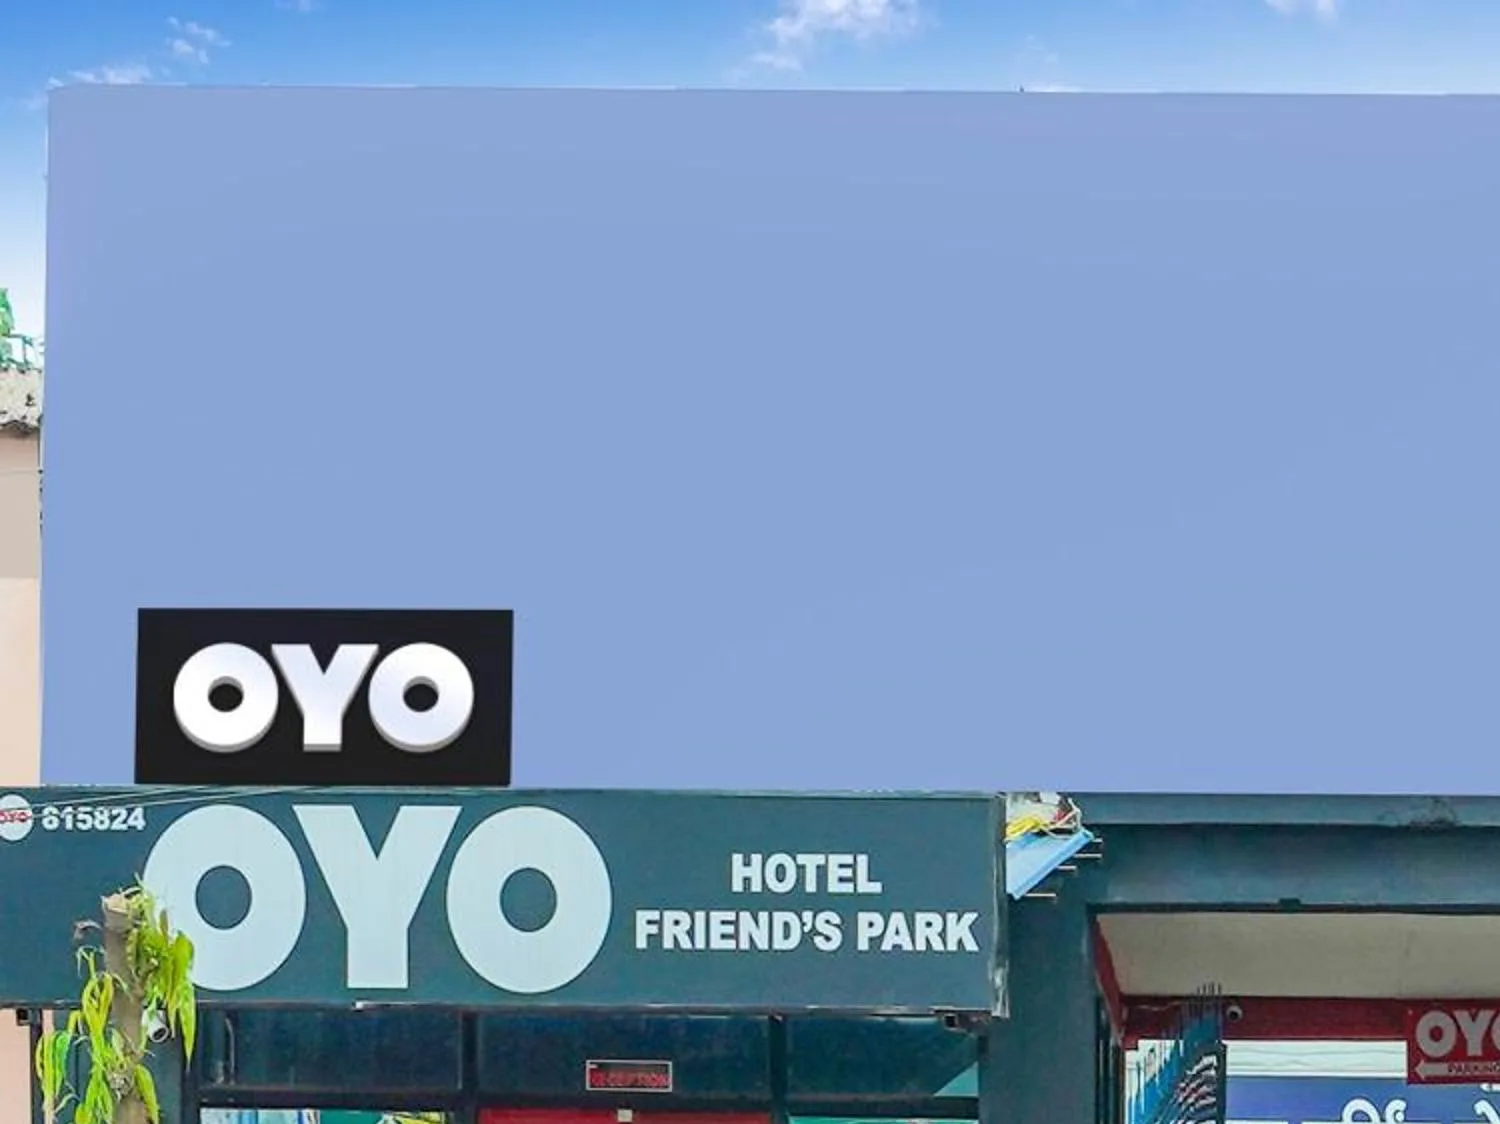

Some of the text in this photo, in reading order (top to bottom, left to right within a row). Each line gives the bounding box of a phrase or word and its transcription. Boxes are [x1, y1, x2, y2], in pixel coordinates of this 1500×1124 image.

[173, 641, 474, 753] OYO
[142, 804, 613, 994] OYO
[731, 853, 883, 894] HOTEL
[634, 909, 981, 952] FRIEND'S PARK
